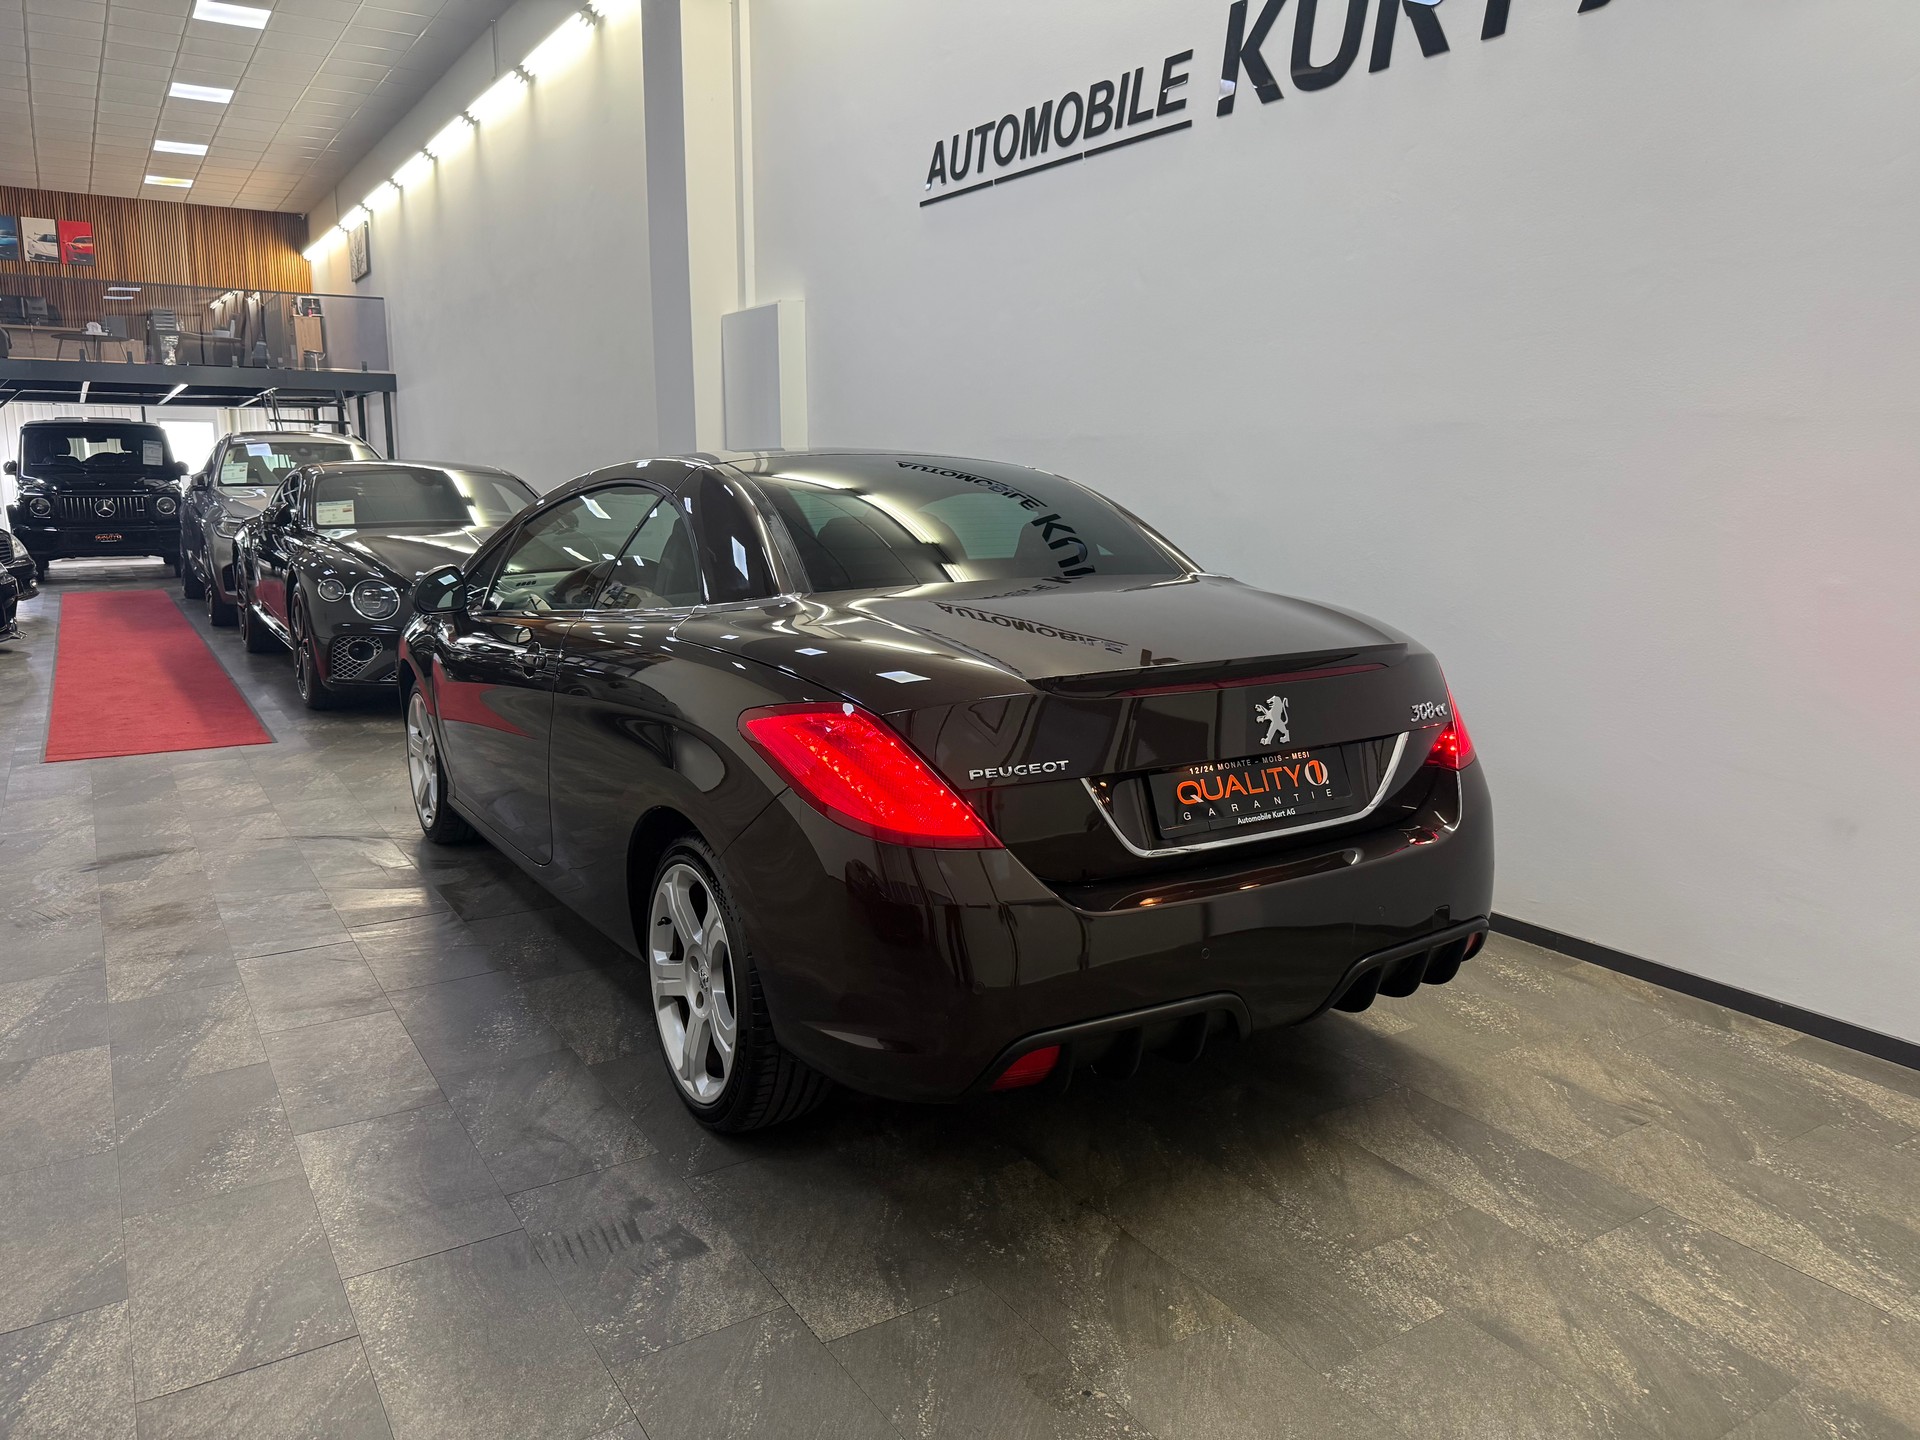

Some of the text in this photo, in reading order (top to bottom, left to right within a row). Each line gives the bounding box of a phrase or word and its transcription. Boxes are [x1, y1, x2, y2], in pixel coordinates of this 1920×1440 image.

[925, 49, 1194, 191] AUTOMOBILE
[968, 760, 1069, 780] PEUGEOT
[1189, 765, 1214, 775] 12/24
[1217, 758, 1251, 771] MONATE
[1262, 755, 1282, 763] MOIS
[1292, 751, 1310, 759] MESI
[1176, 764, 1300, 805] QUALITY
[1183, 788, 1333, 821] GARANTIE
[1237, 808, 1296, 825] Automobile Kurt AG
